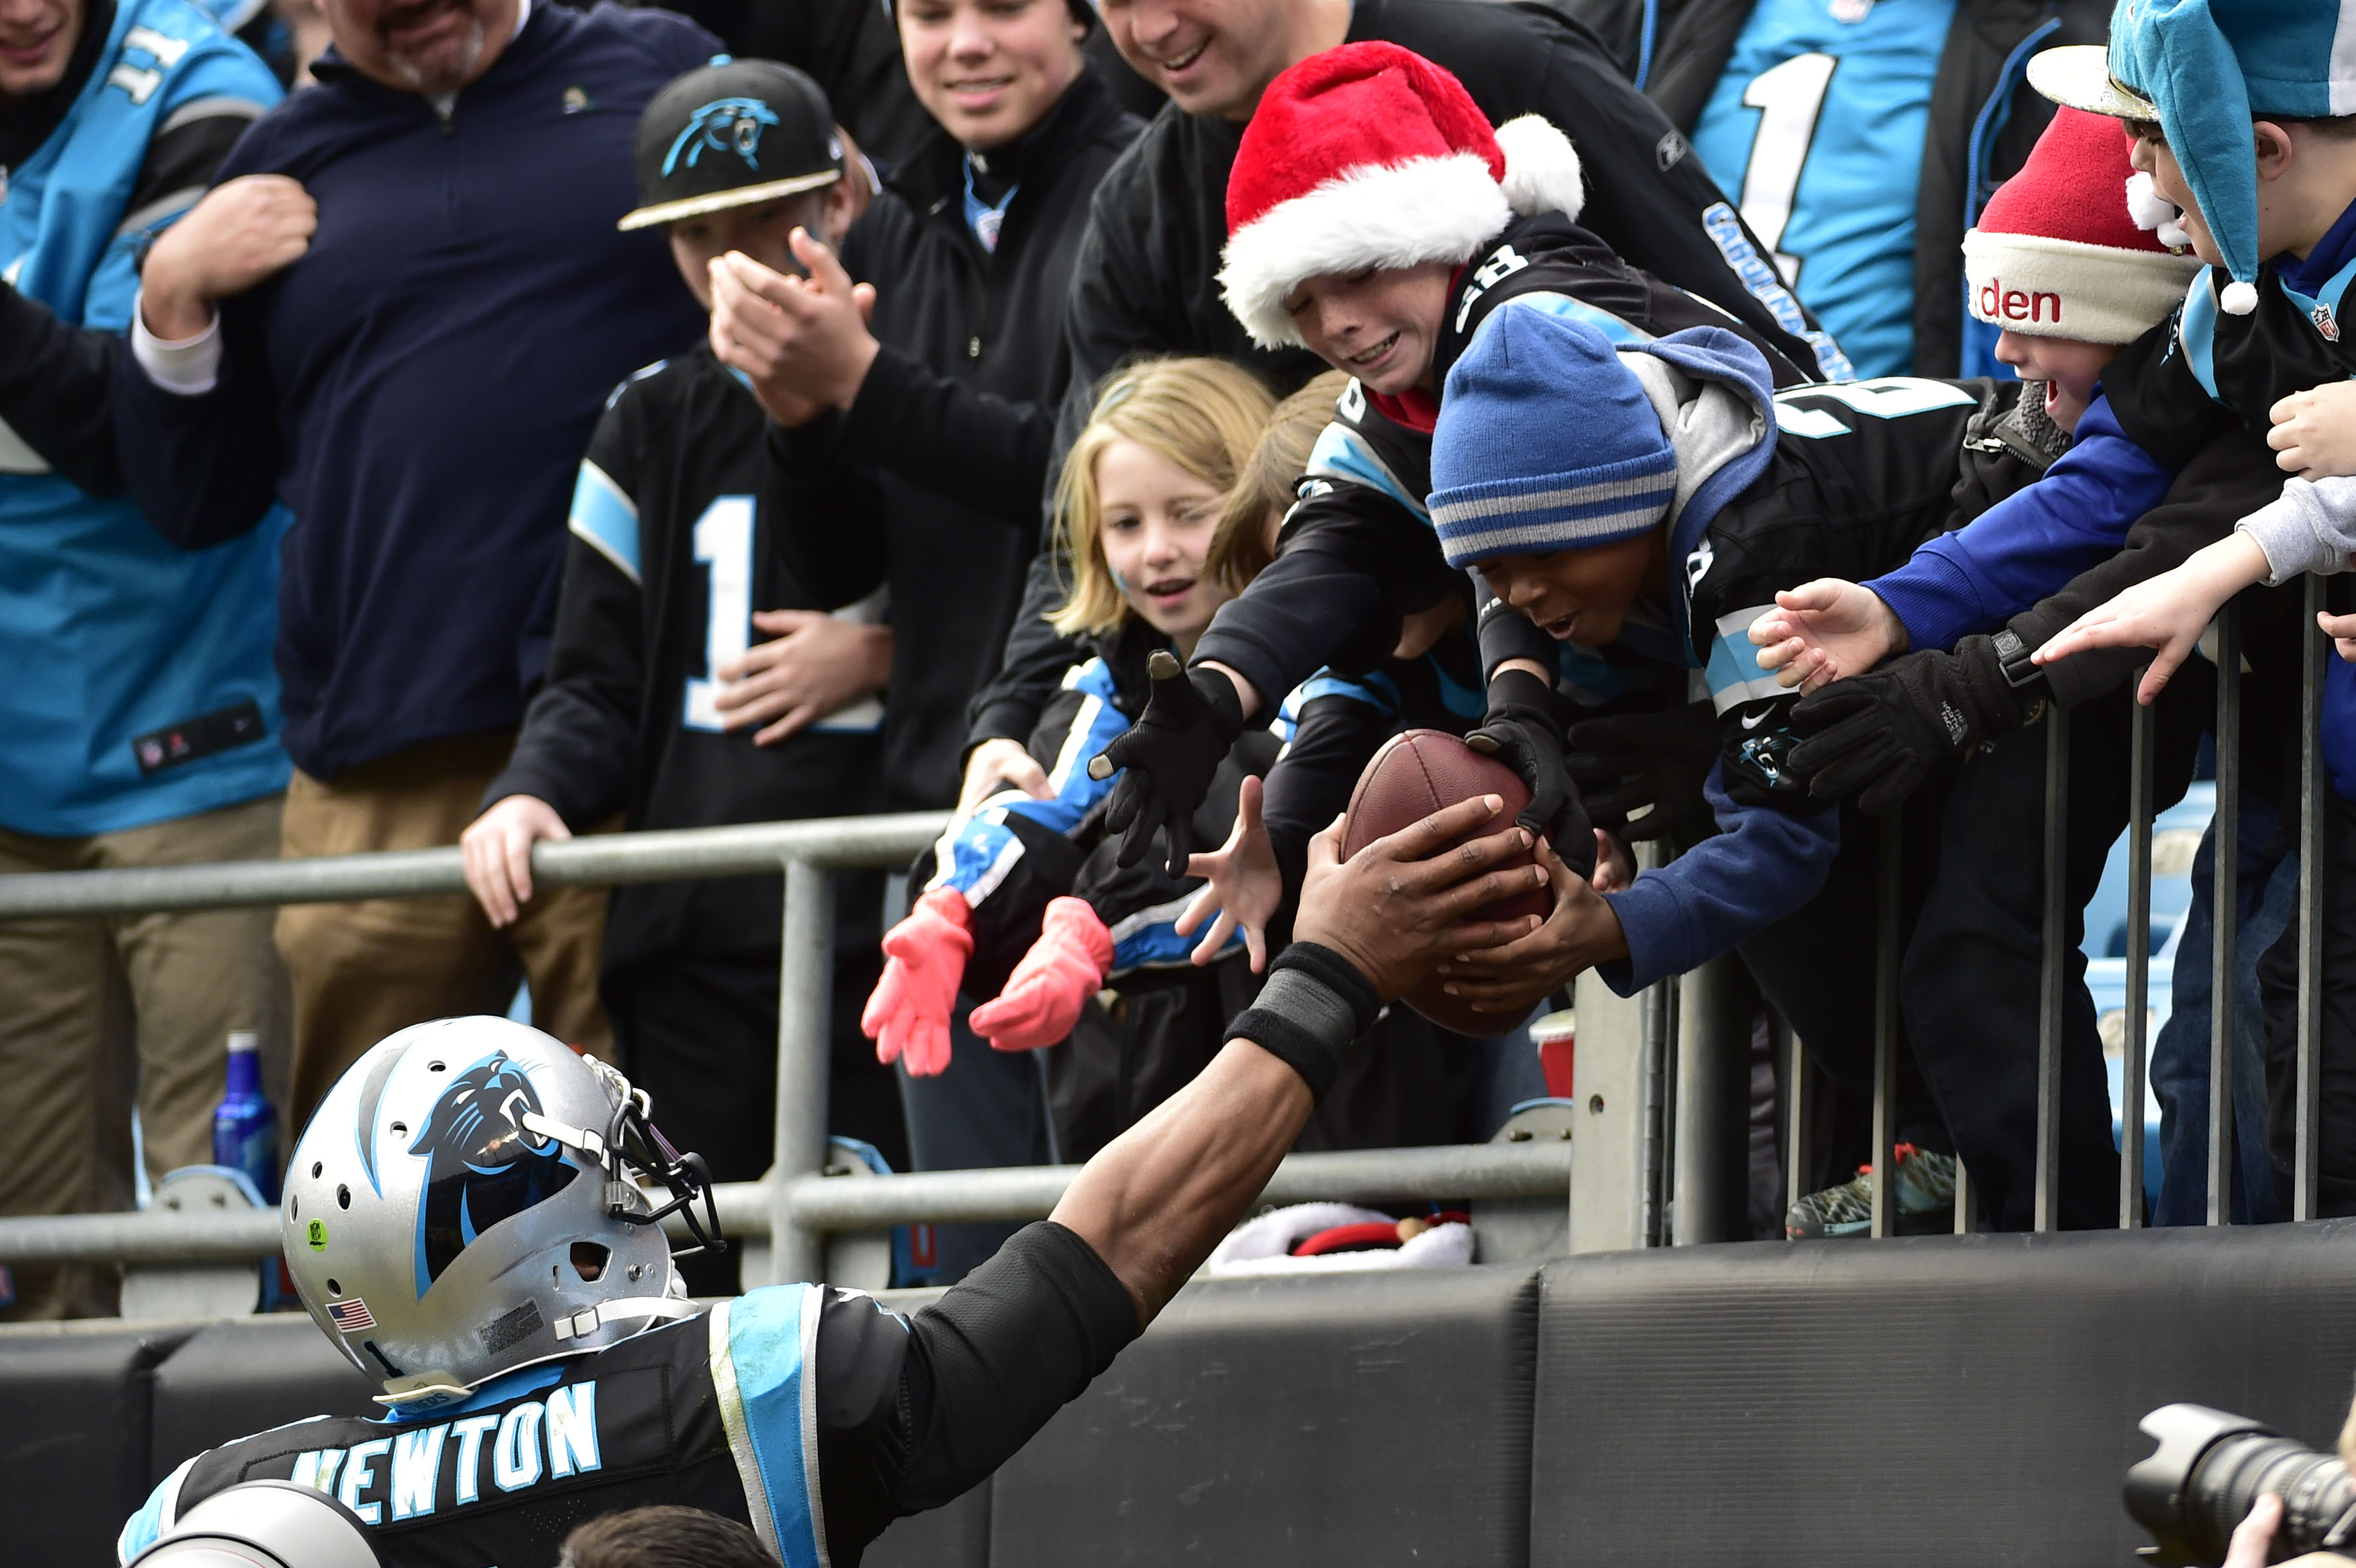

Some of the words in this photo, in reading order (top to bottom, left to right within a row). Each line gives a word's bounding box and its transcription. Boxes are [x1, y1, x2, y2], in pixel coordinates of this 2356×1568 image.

[1740, 51, 1839, 290] 1
[1702, 201, 1807, 333] CAROLINA
[1974, 277, 2061, 323] den
[1942, 700, 1960, 728] NORTH
[364, 1340, 406, 1378] 1
